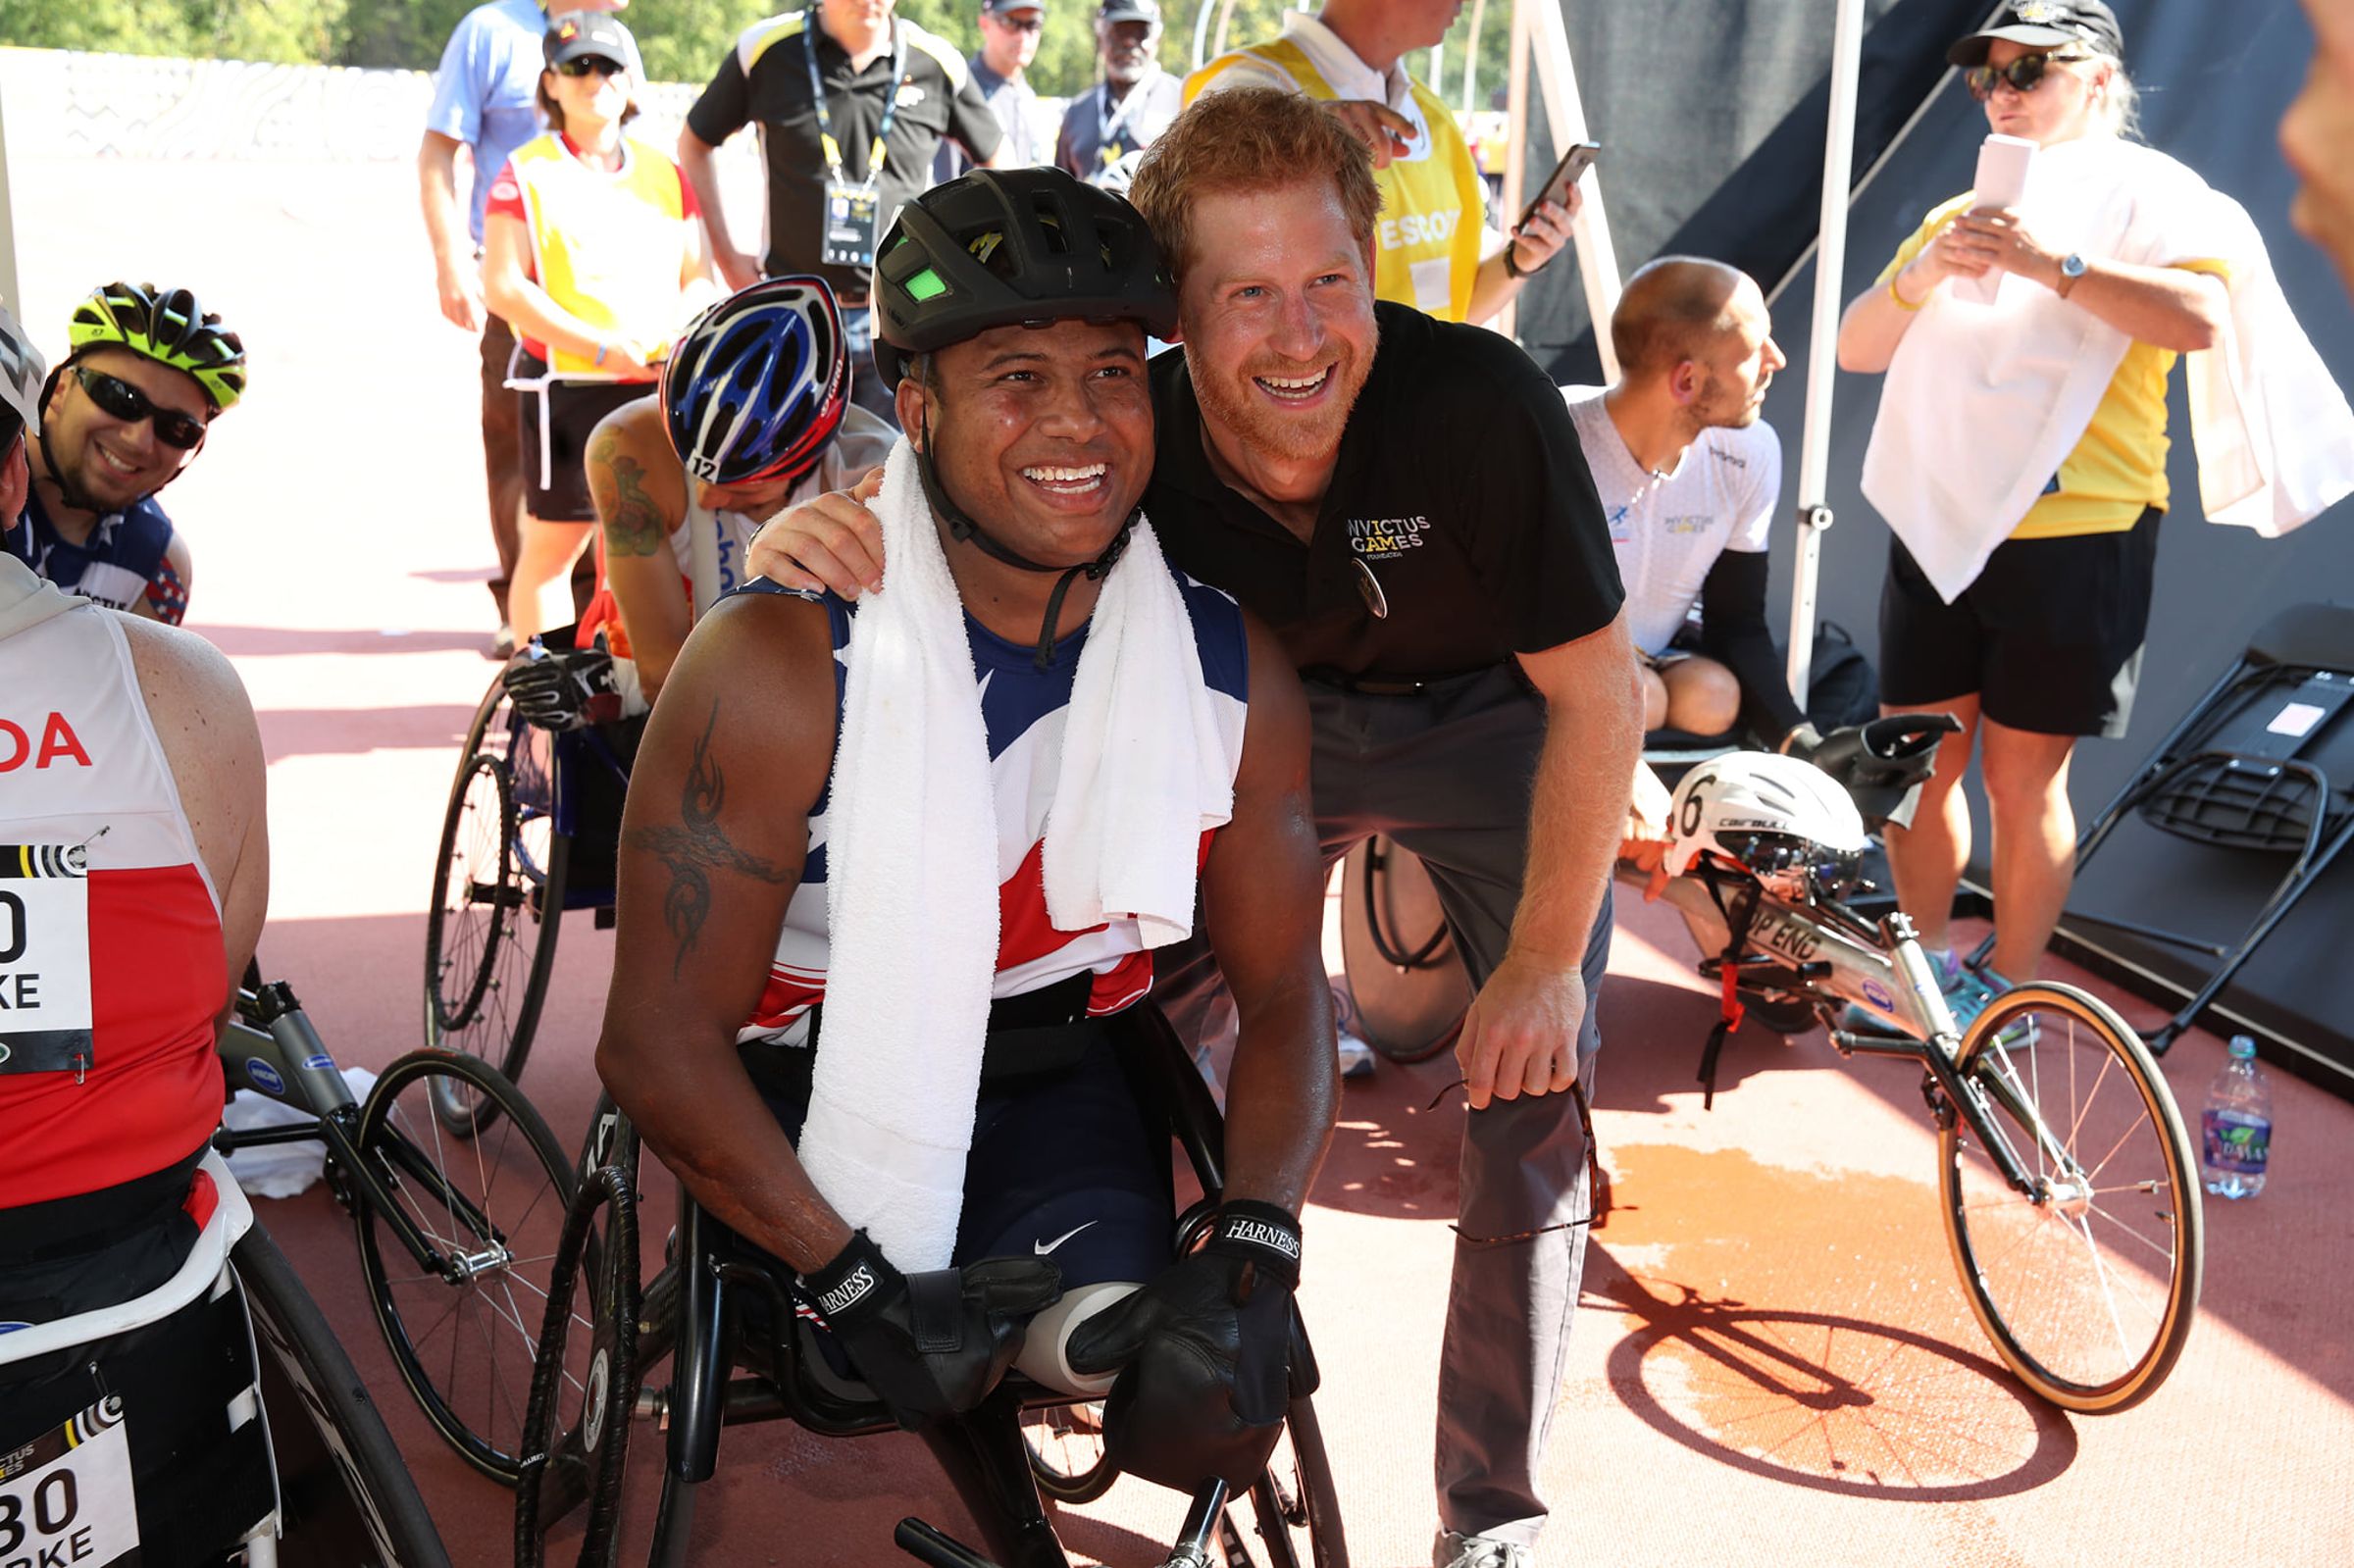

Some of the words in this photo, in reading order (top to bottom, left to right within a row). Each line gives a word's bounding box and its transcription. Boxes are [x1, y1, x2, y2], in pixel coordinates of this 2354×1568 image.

[691, 456, 717, 482] 12
[1348, 515, 1431, 536] NVICTUS
[1351, 533, 1423, 553] GAMES
[1680, 774, 1716, 837] 6
[1226, 1220, 1301, 1259] HARNESS
